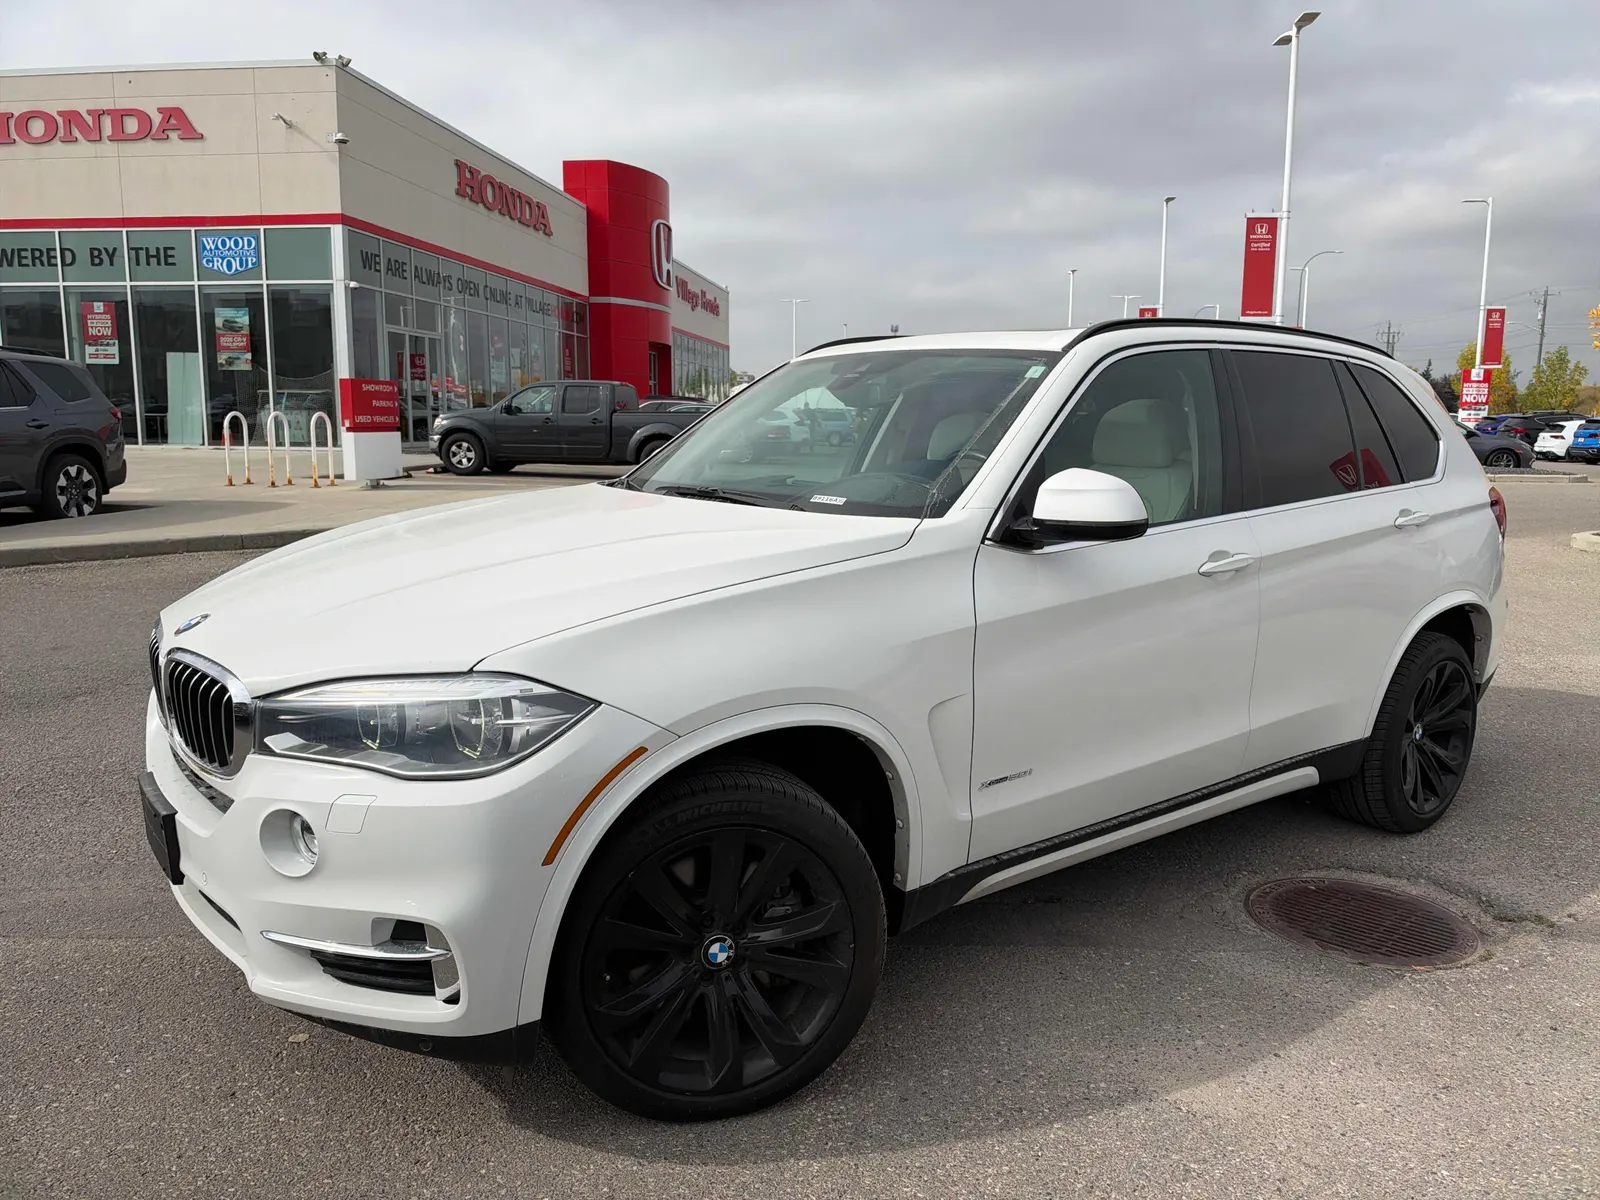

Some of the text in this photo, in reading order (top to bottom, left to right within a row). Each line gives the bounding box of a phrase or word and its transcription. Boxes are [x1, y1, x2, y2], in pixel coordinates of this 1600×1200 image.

[454, 159, 553, 237] HONDA
[201, 236, 256, 250] WOOD
[89, 247, 118, 267] BY
[129, 246, 177, 267] THE
[203, 257, 257, 275] GROUP
[360, 249, 381, 273] WE
[386, 257, 408, 280] ARE
[413, 265, 453, 292] ALWAYS
[456, 277, 481, 298] OPEN
[514, 293, 524, 310] AT
[675, 275, 700, 312] Village
[88, 326, 112, 336] NOW
[361, 383, 393, 392] SHOWROOM
[372, 399, 394, 408] PARKING
[1462, 394, 1488, 403] NOW
[354, 415, 395, 423] USED VEHICLES
